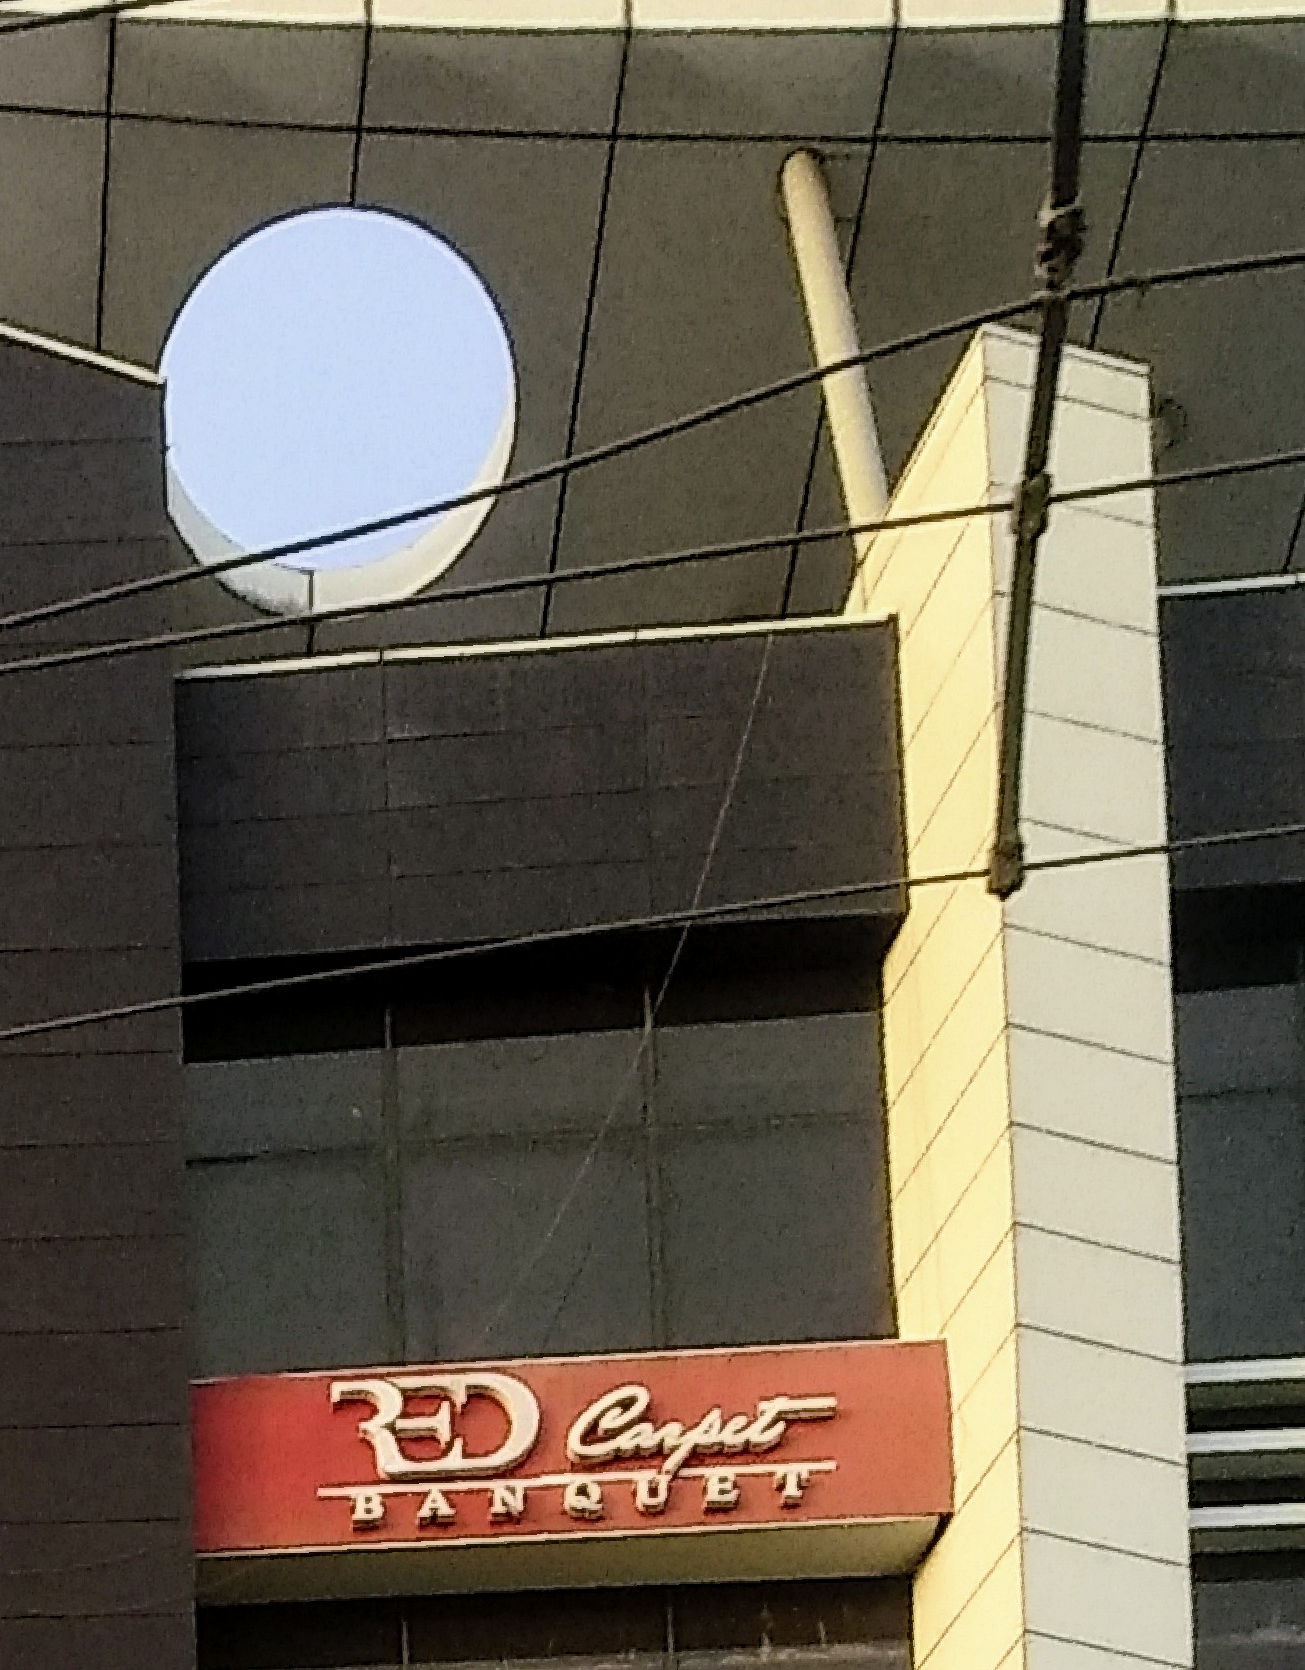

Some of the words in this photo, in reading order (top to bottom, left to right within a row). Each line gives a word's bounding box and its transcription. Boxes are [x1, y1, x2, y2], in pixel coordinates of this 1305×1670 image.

[330, 1371, 541, 1478] RED
[567, 1384, 837, 1477] Carpet
[350, 1473, 810, 1528] BANQUET
